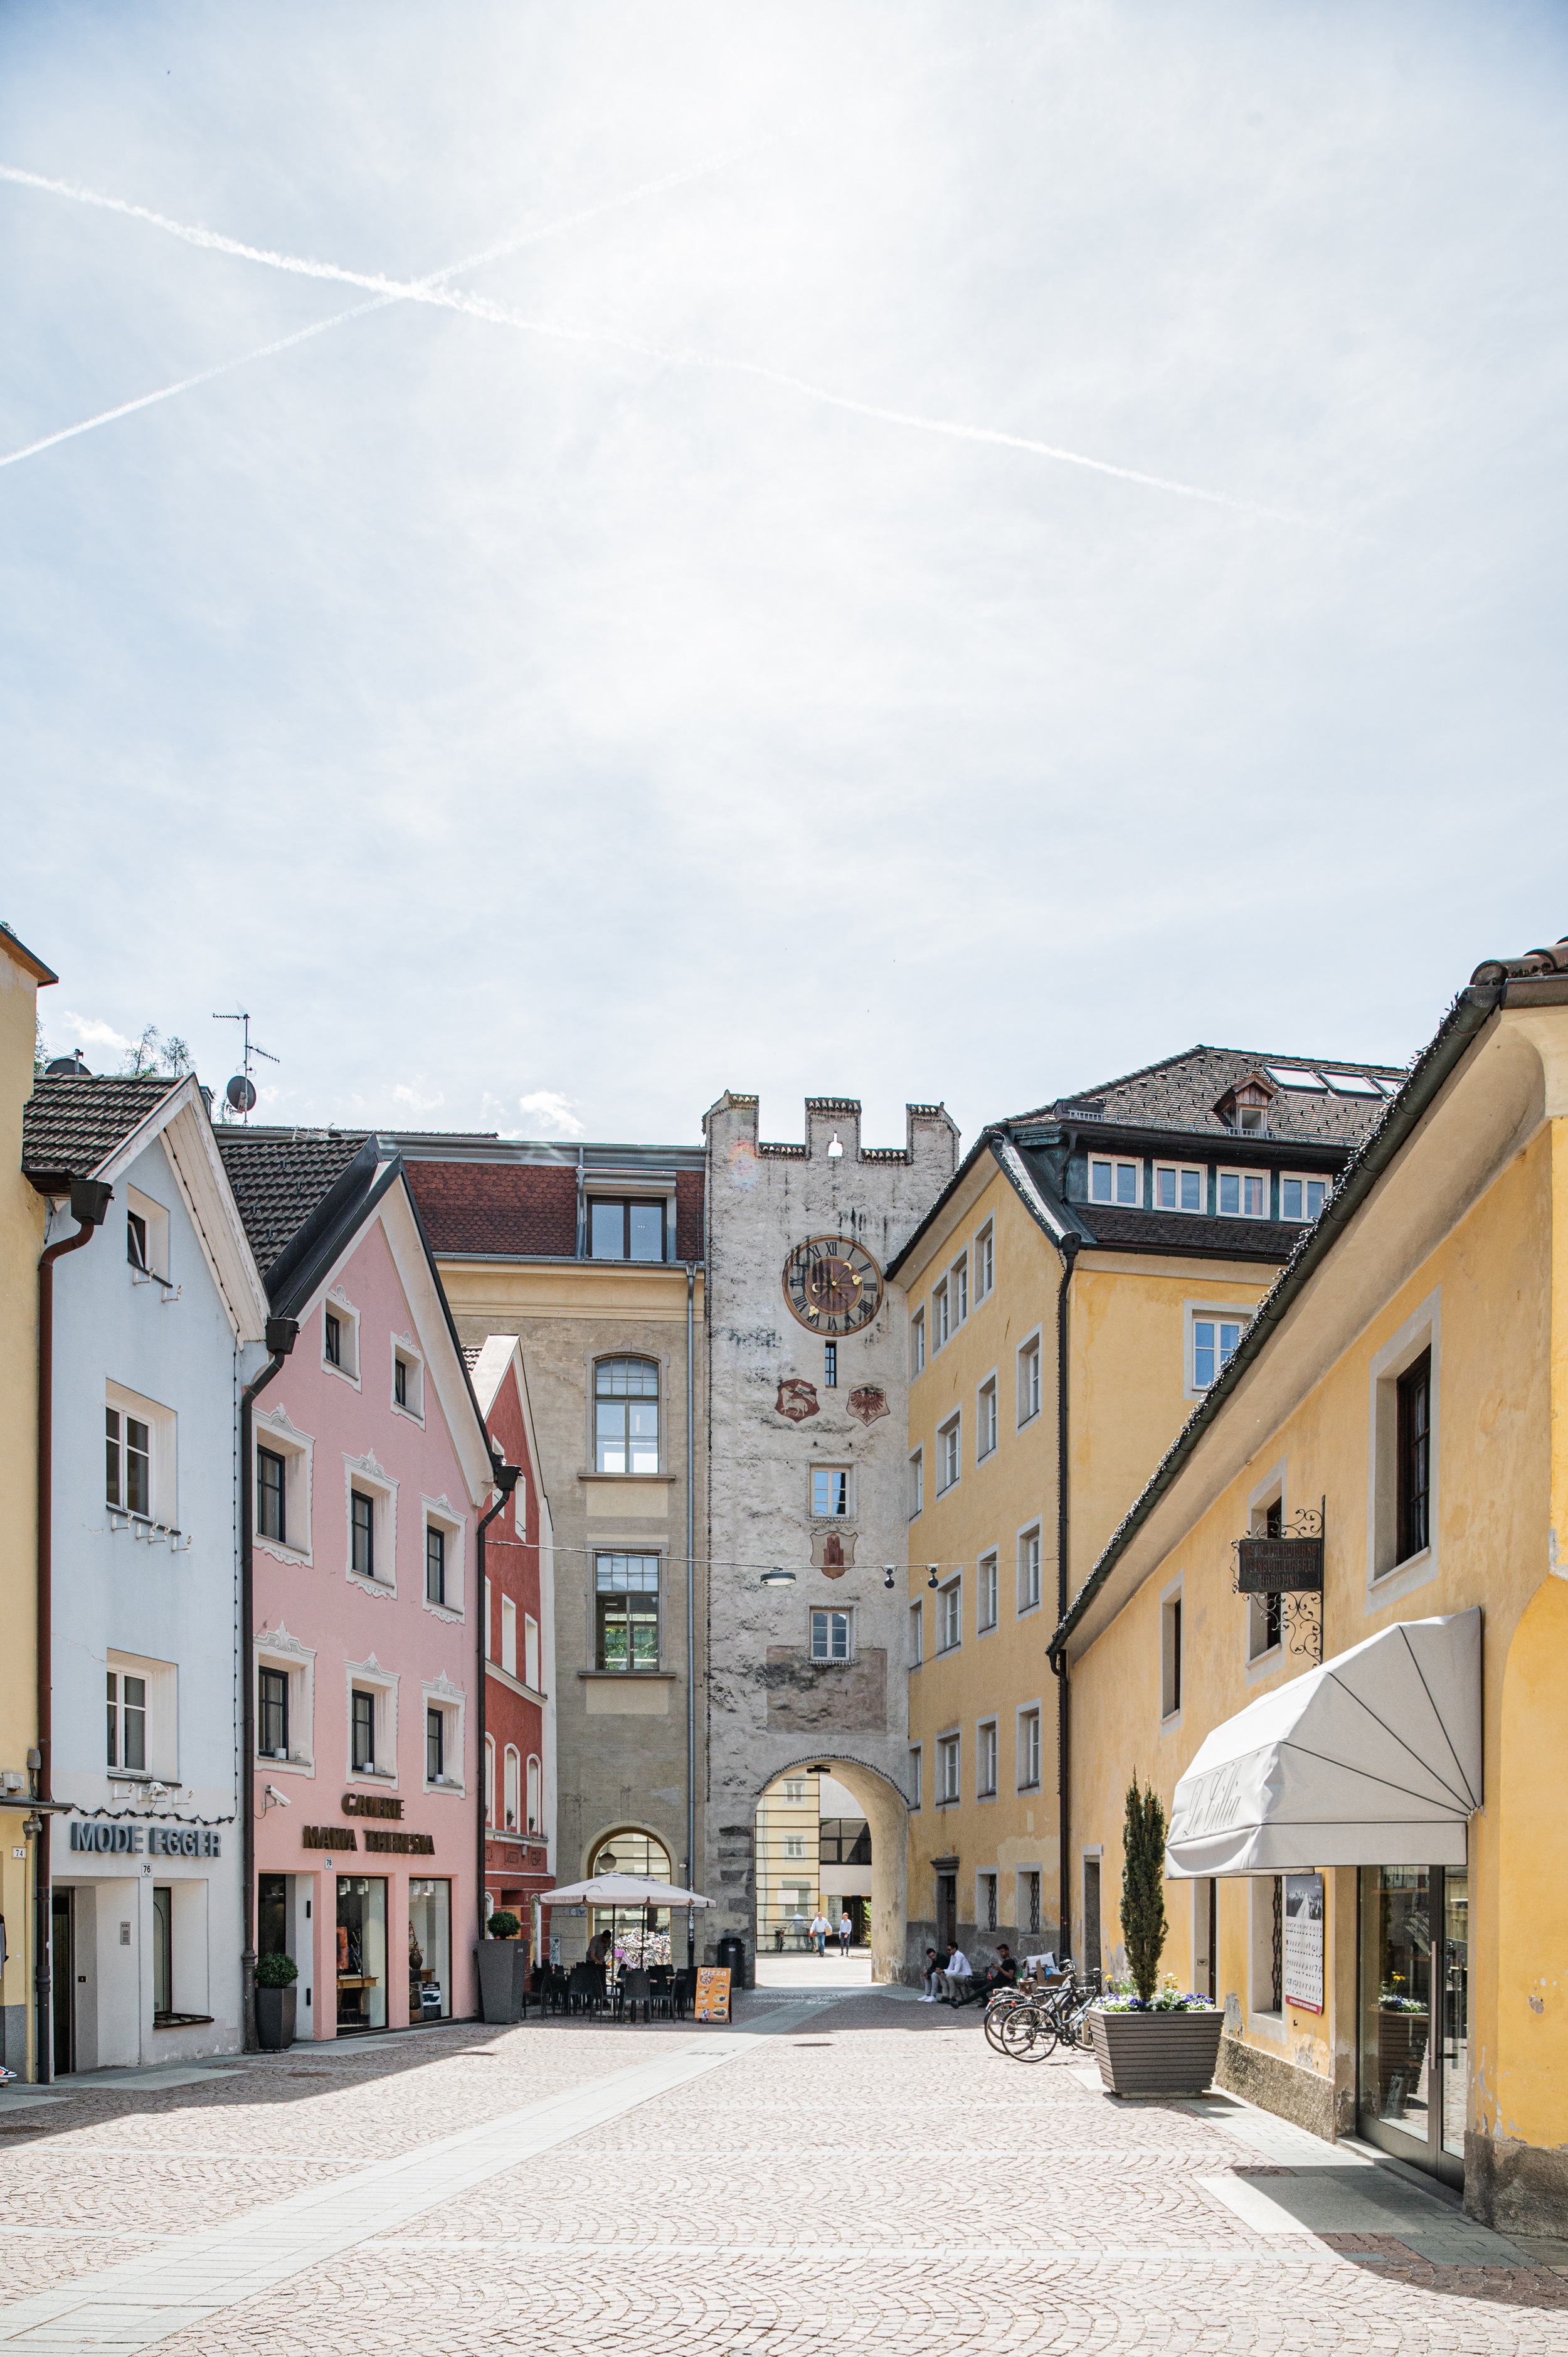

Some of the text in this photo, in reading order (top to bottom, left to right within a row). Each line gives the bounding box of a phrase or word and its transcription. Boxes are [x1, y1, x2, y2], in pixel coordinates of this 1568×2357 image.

[825, 1242, 837, 1256] XII
[847, 1248, 855, 1260] I
[859, 1262, 872, 1273] II
[864, 1283, 877, 1291] III
[793, 1295, 808, 1313] VIII
[827, 1316, 838, 1331] VI
[341, 1793, 405, 1820] GALERIE
[70, 1822, 221, 1858] MODE EGGER
[303, 1825, 435, 1855] MARIA THERESIA
[16, 1849, 23, 1857] 74
[143, 1865, 151, 1873] 76
[701, 1968, 727, 1976] Pizza
